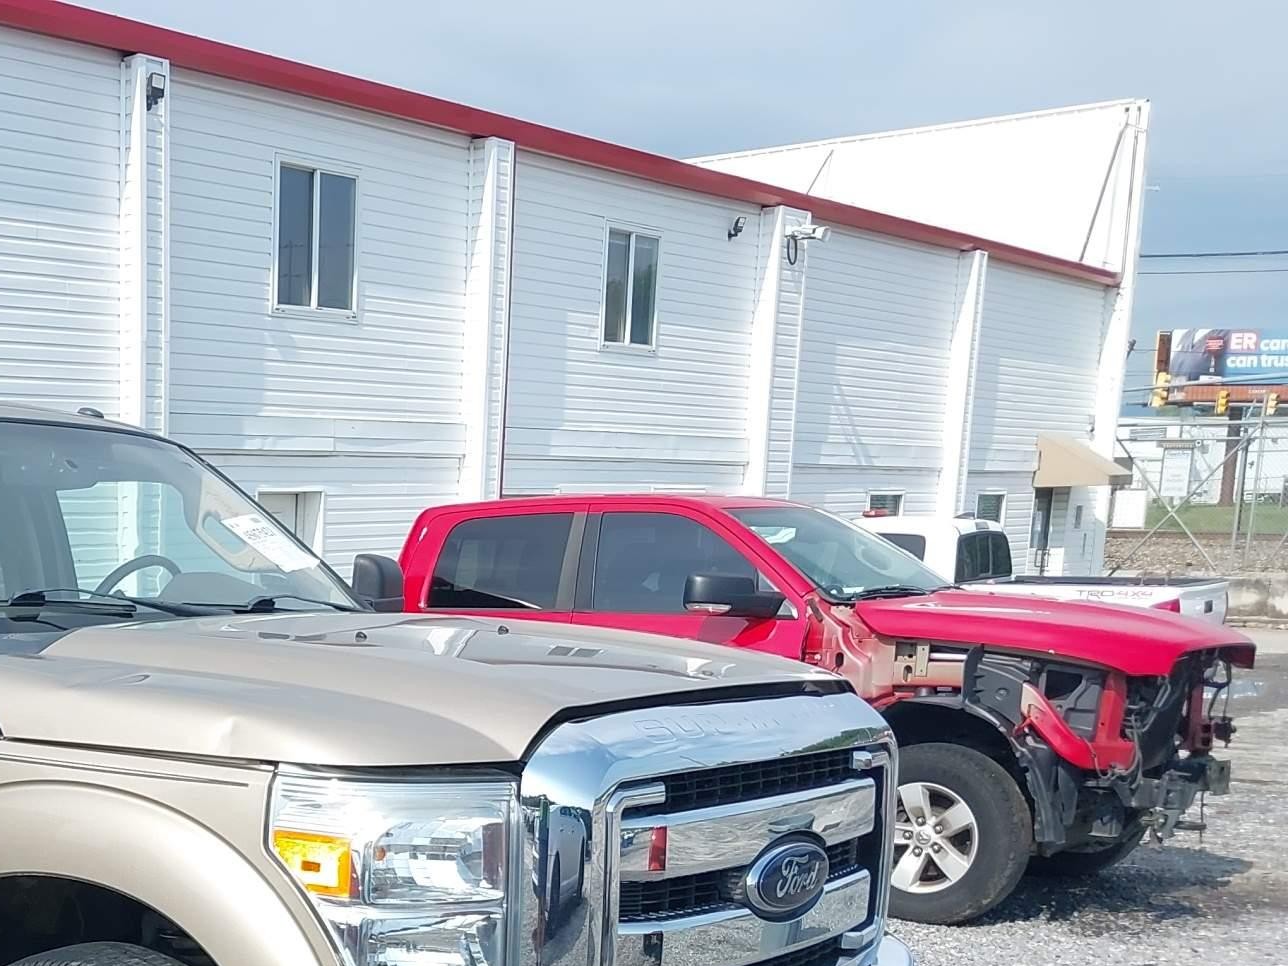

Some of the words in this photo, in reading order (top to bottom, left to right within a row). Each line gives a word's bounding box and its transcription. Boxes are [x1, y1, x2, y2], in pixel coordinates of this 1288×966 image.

[1230, 332, 1257, 350] ER
[1226, 355, 1258, 368] can
[776, 854, 820, 898] Ford
